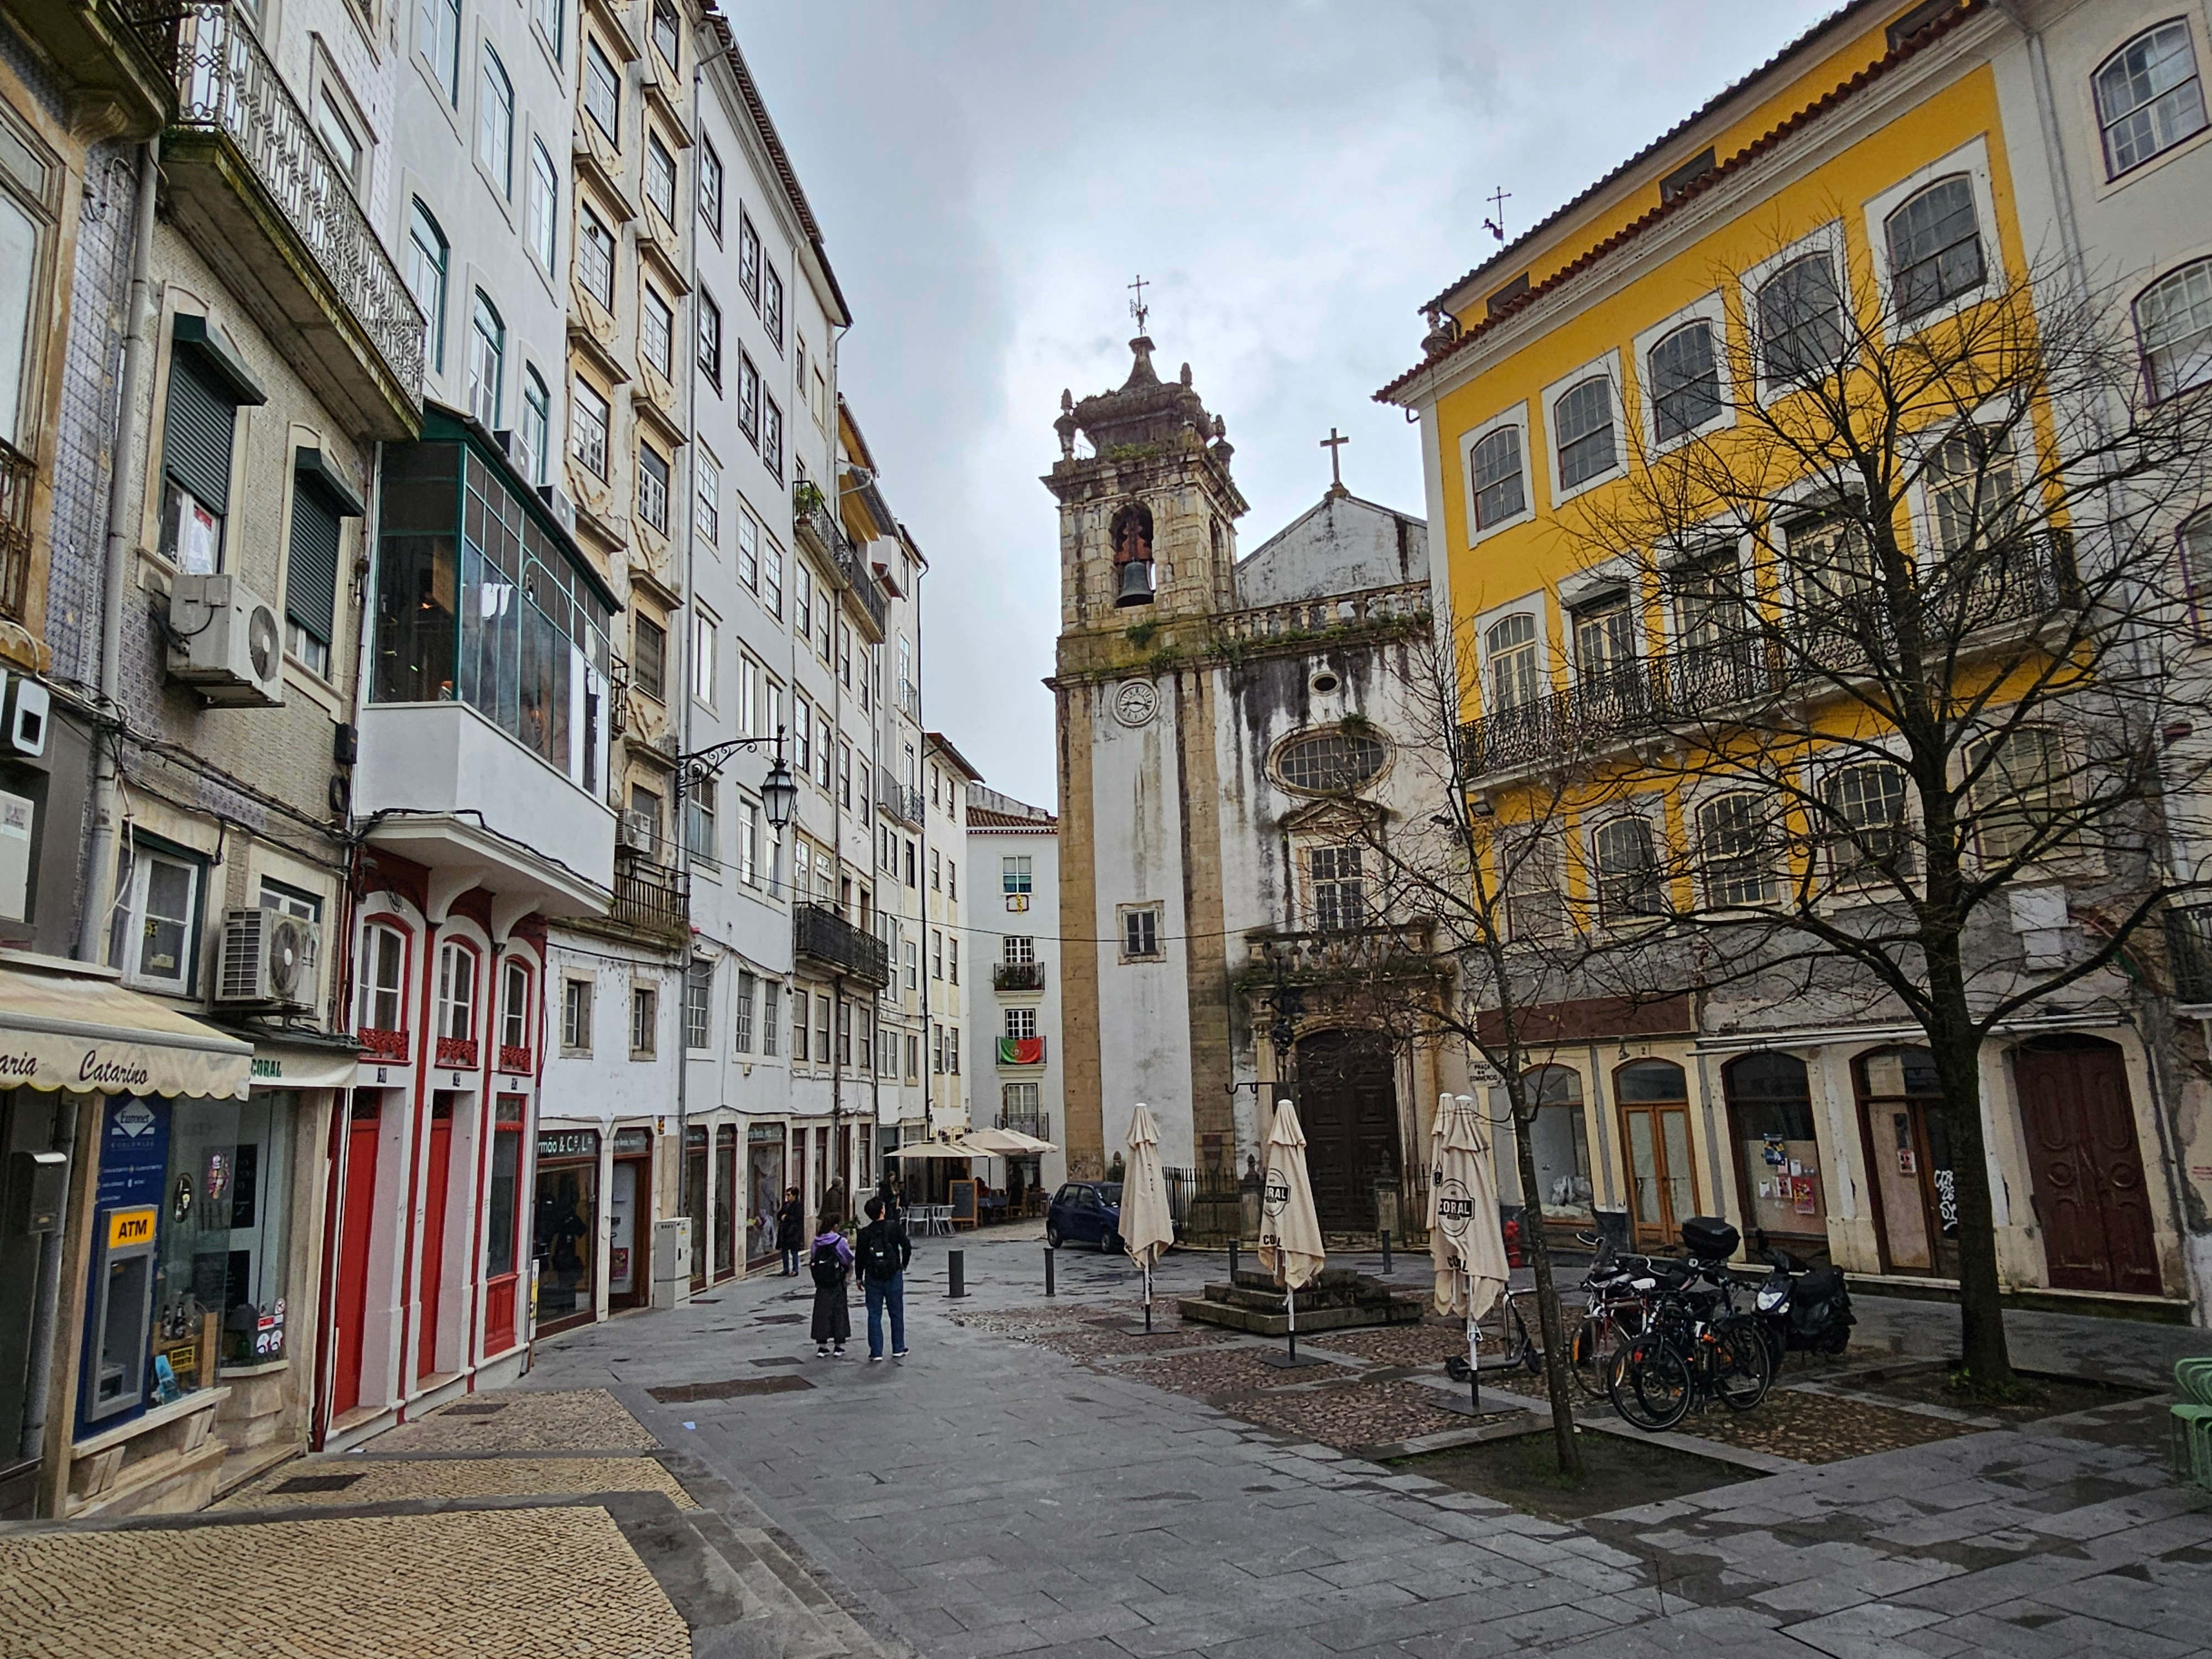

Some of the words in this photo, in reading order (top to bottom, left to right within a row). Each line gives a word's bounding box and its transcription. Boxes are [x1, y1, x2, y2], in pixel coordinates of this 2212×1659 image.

[79, 1050, 149, 1084] Catarino
[251, 1058, 281, 1078] CORAL
[120, 1110, 150, 1124] Euronet
[559, 1136, 565, 1152] &
[1265, 1187, 1286, 1199] RAL
[118, 1219, 148, 1239] ATM
